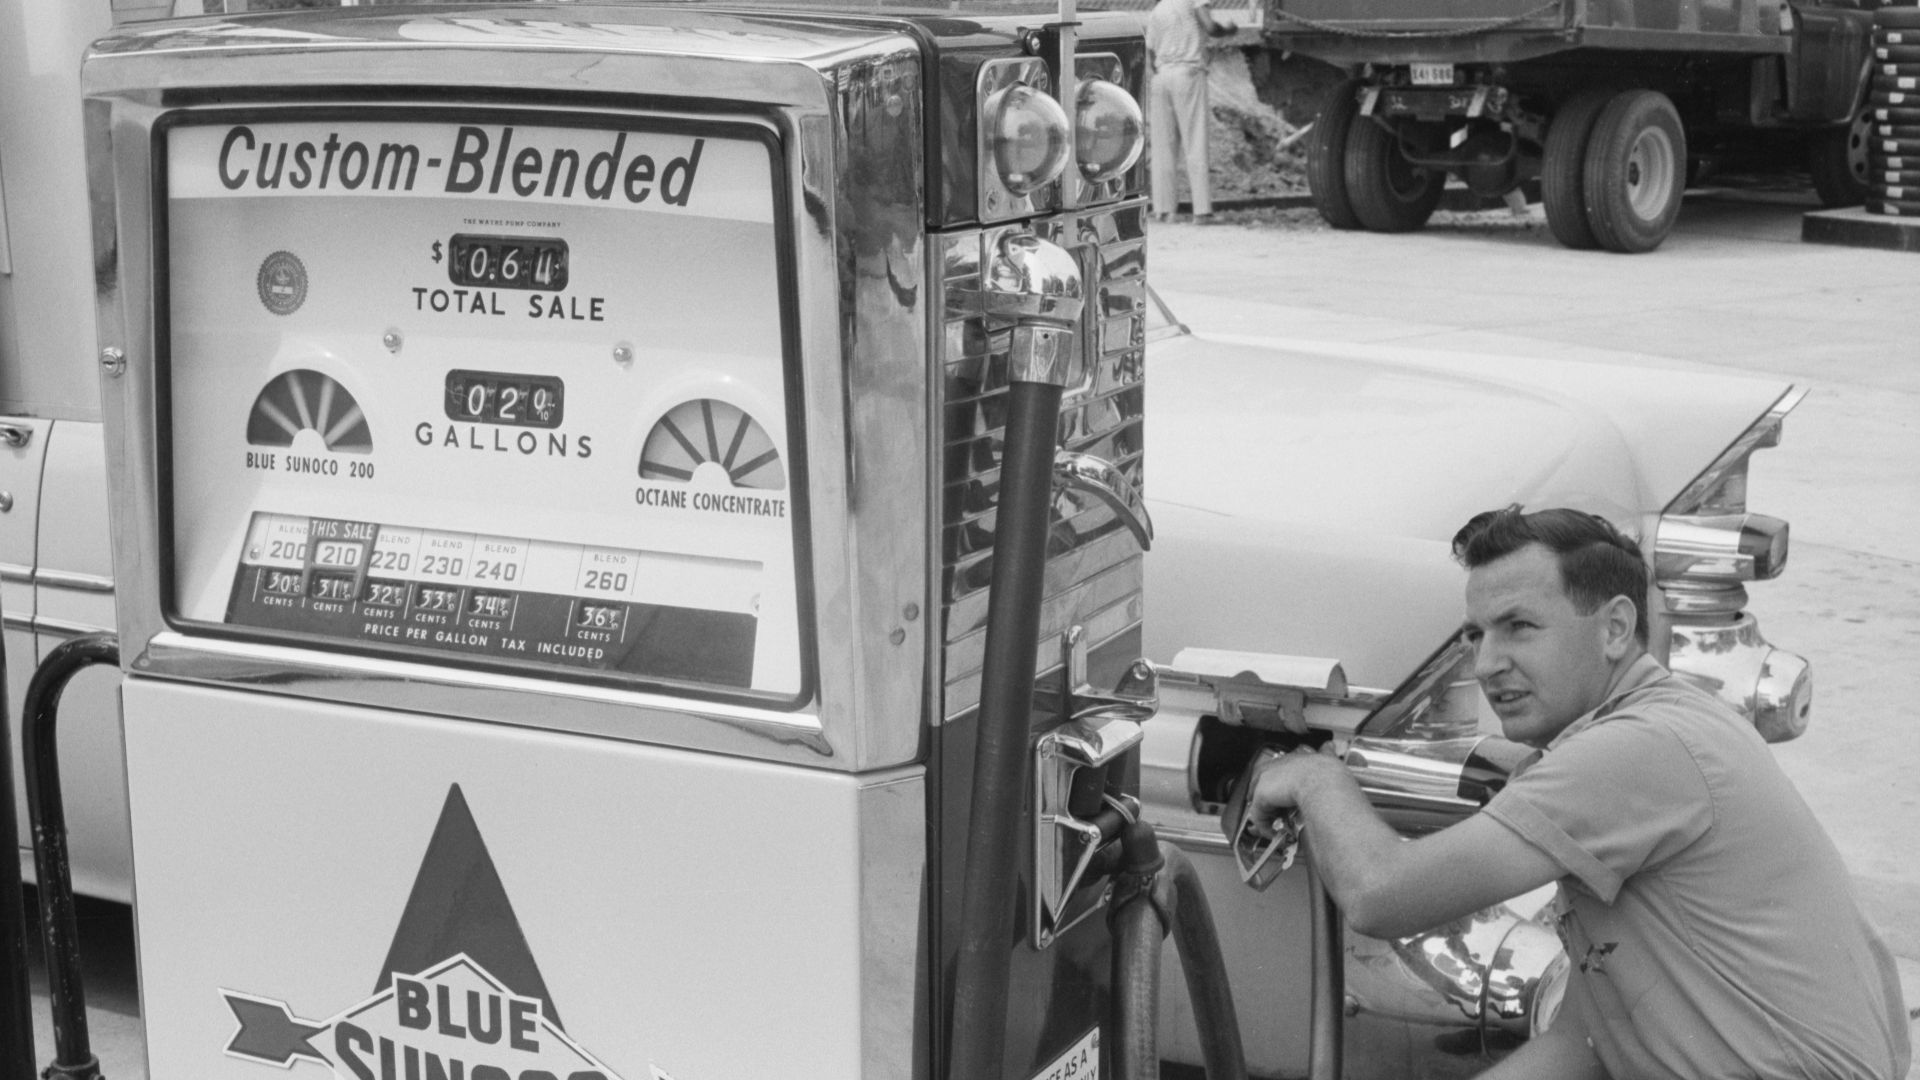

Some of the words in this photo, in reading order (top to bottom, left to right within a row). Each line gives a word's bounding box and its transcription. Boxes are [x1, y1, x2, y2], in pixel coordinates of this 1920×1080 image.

[218, 125, 705, 207] Custom-Blended
[412, 287, 506, 315] TOTAL
[528, 294, 605, 321] SALE
[415, 421, 592, 458] GALLONS
[246, 452, 276, 470] BLUE
[286, 455, 339, 476] SUNOCO
[349, 461, 375, 479] 200
[635, 487, 687, 509] OCTANE
[692, 492, 785, 518] CONCENTRATE
[311, 520, 338, 537] THIS
[343, 522, 375, 540] SALE
[380, 534, 411, 545] BLEND
[270, 540, 306, 561] 200
[431, 539, 463, 549] BLEND
[484, 544, 517, 554] BLEND
[322, 545, 357, 566] 210
[370, 550, 410, 571] 220
[421, 555, 463, 576] 230
[594, 554, 628, 564] BLEND
[474, 560, 517, 582] 240
[584, 570, 628, 592] 260
[263, 596, 294, 607] CENTS
[313, 602, 344, 613] CENTS
[363, 607, 395, 619] CENTS
[415, 613, 447, 625] CENTS
[468, 619, 501, 630] CENTS
[364, 623, 400, 637] PRICE
[406, 627, 428, 640] PER
[435, 630, 489, 646] GALLON
[501, 637, 526, 651] TAX
[537, 642, 604, 660] INCLUDED
[577, 630, 611, 642] CENTS
[396, 978, 540, 1054] BLUE
